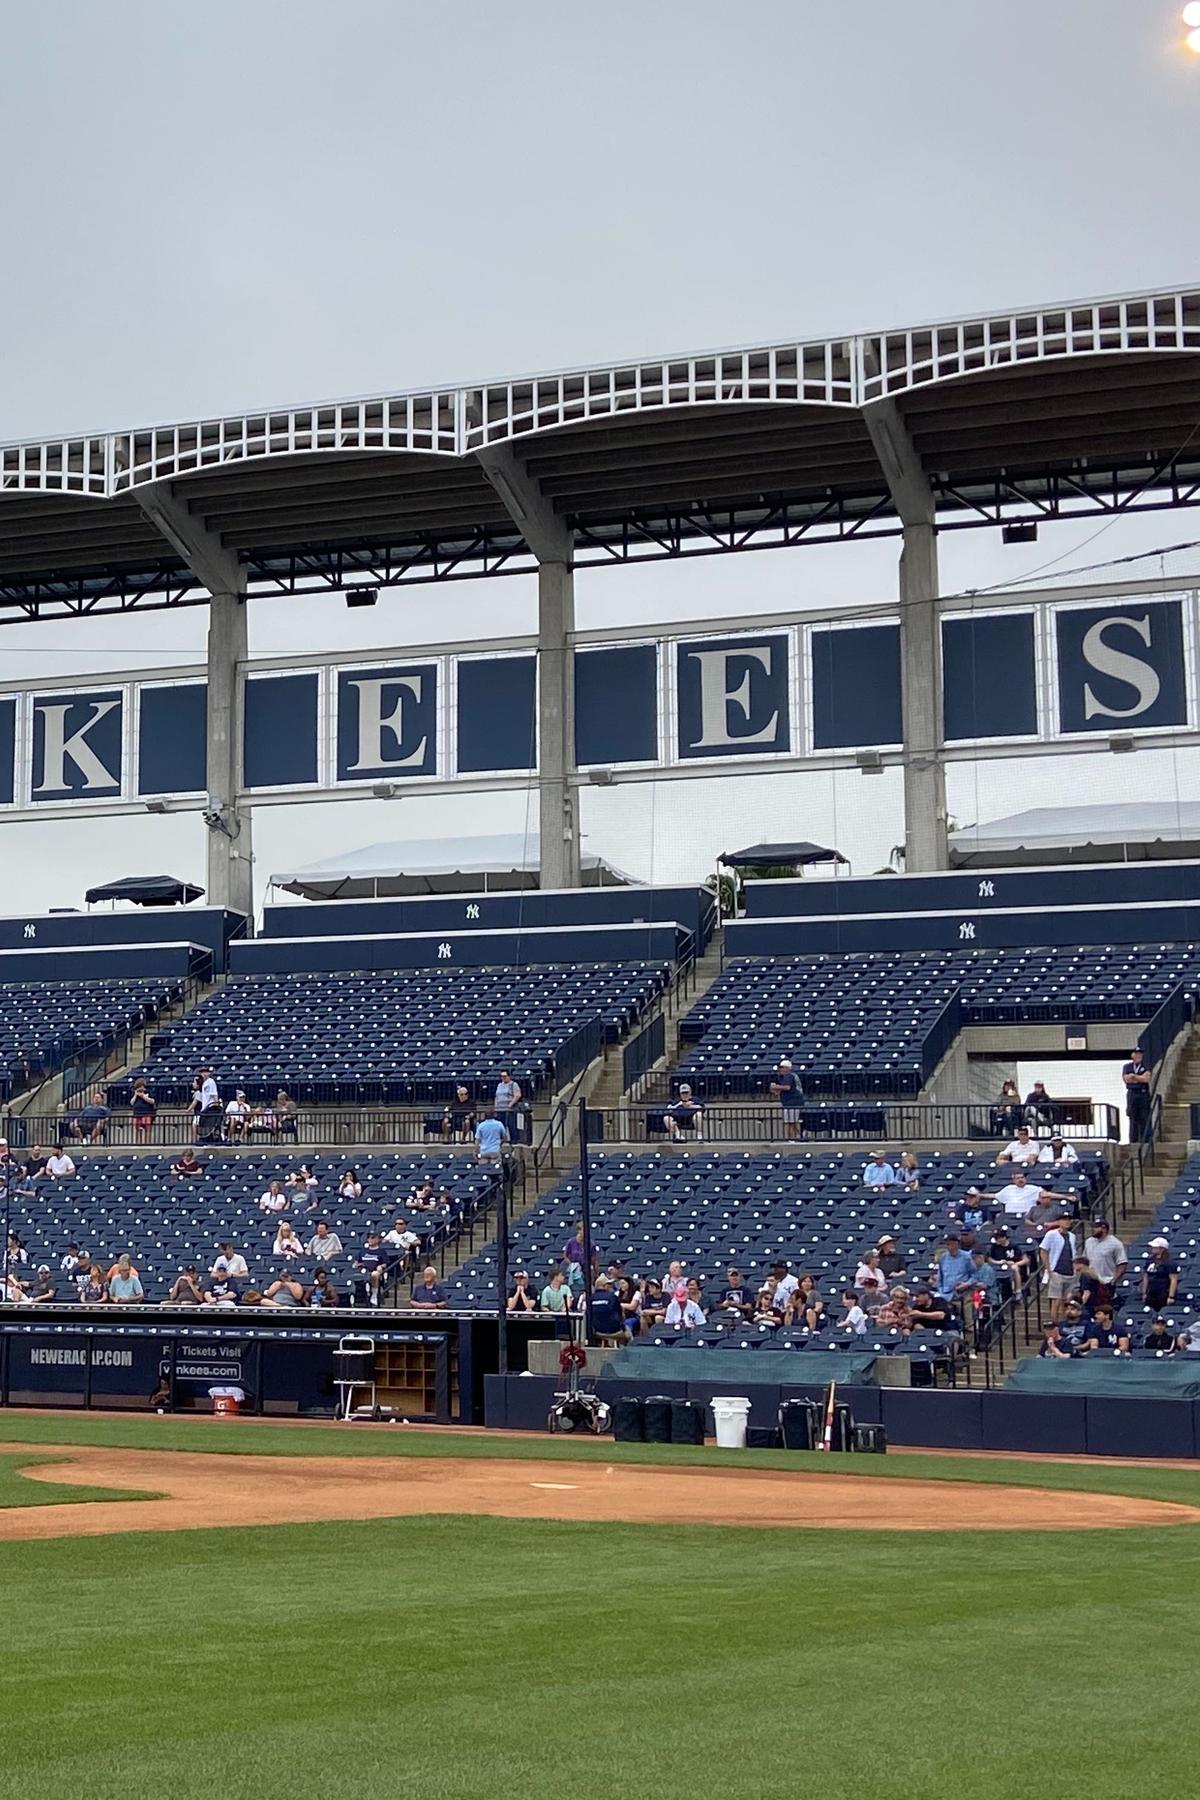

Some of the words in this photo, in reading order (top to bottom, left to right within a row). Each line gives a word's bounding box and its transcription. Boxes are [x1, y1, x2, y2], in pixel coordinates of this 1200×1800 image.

[30, 1348, 133, 1366] NEWERACP.COM
[182, 1346, 216, 1357] Tickets
[219, 1347, 241, 1358] Visit
[163, 1365, 237, 1376] ynkees.com
